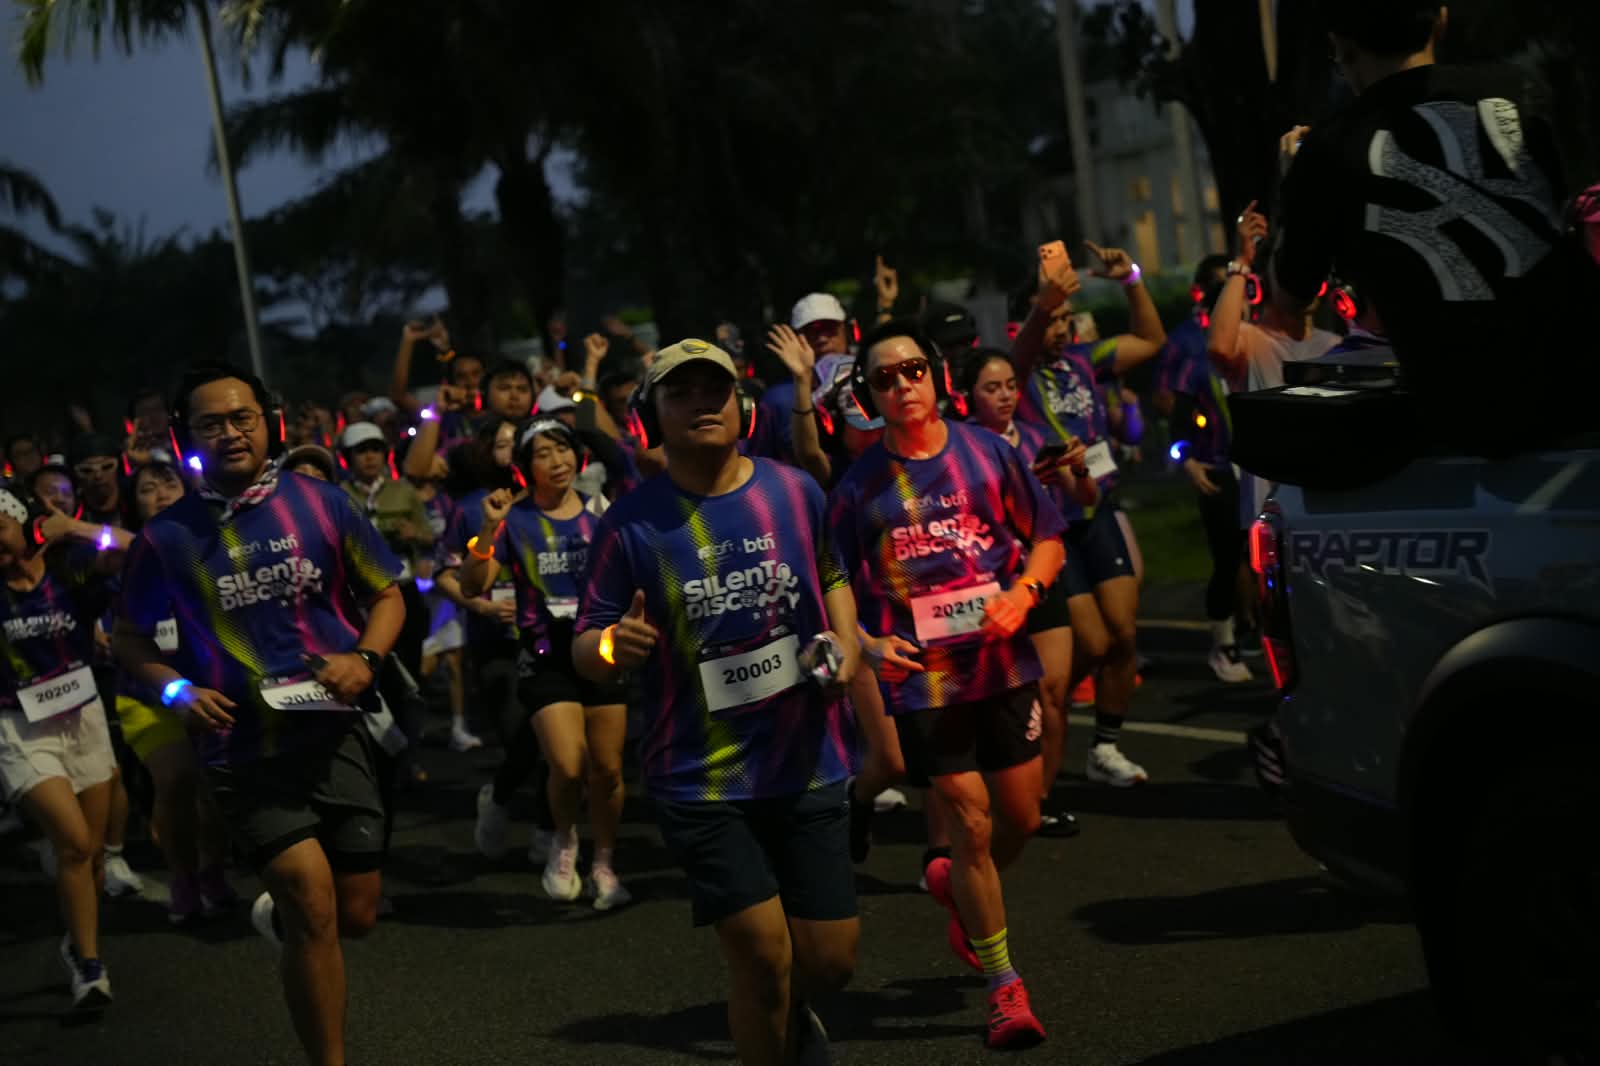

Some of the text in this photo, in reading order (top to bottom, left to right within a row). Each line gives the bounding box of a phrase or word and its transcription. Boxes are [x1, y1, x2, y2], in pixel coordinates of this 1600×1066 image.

[1288, 528, 1495, 592] RAPTOR
[932, 597, 984, 618] 20213
[722, 654, 782, 685] 20003
[35, 680, 80, 704] 20205
